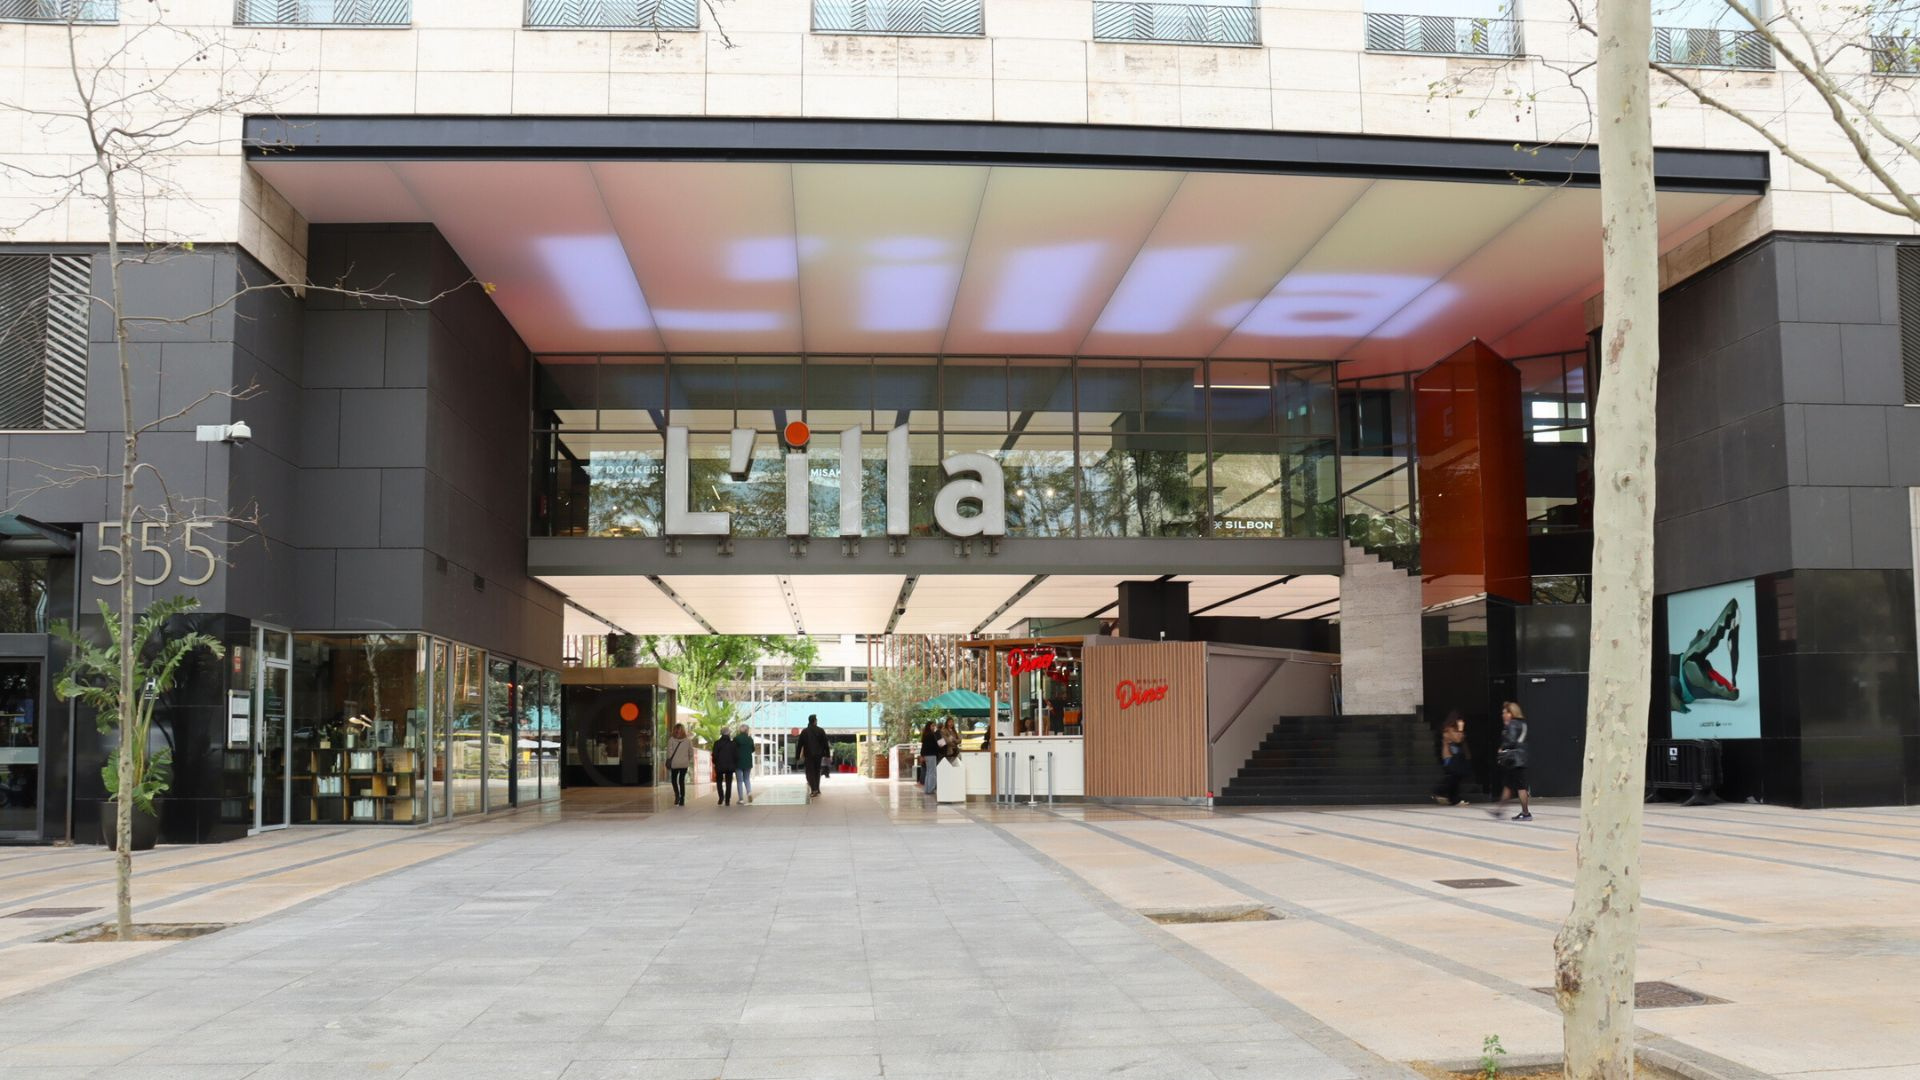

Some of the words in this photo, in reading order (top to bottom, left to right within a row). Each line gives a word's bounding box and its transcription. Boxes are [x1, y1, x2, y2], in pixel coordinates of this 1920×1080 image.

[606, 465, 665, 474] DOCKERS
[665, 421, 1006, 537] L'illa
[1225, 520, 1274, 529] SILBON
[92, 521, 216, 586] 555
[1007, 647, 1055, 677] Dino
[1115, 679, 1169, 710] Dino
